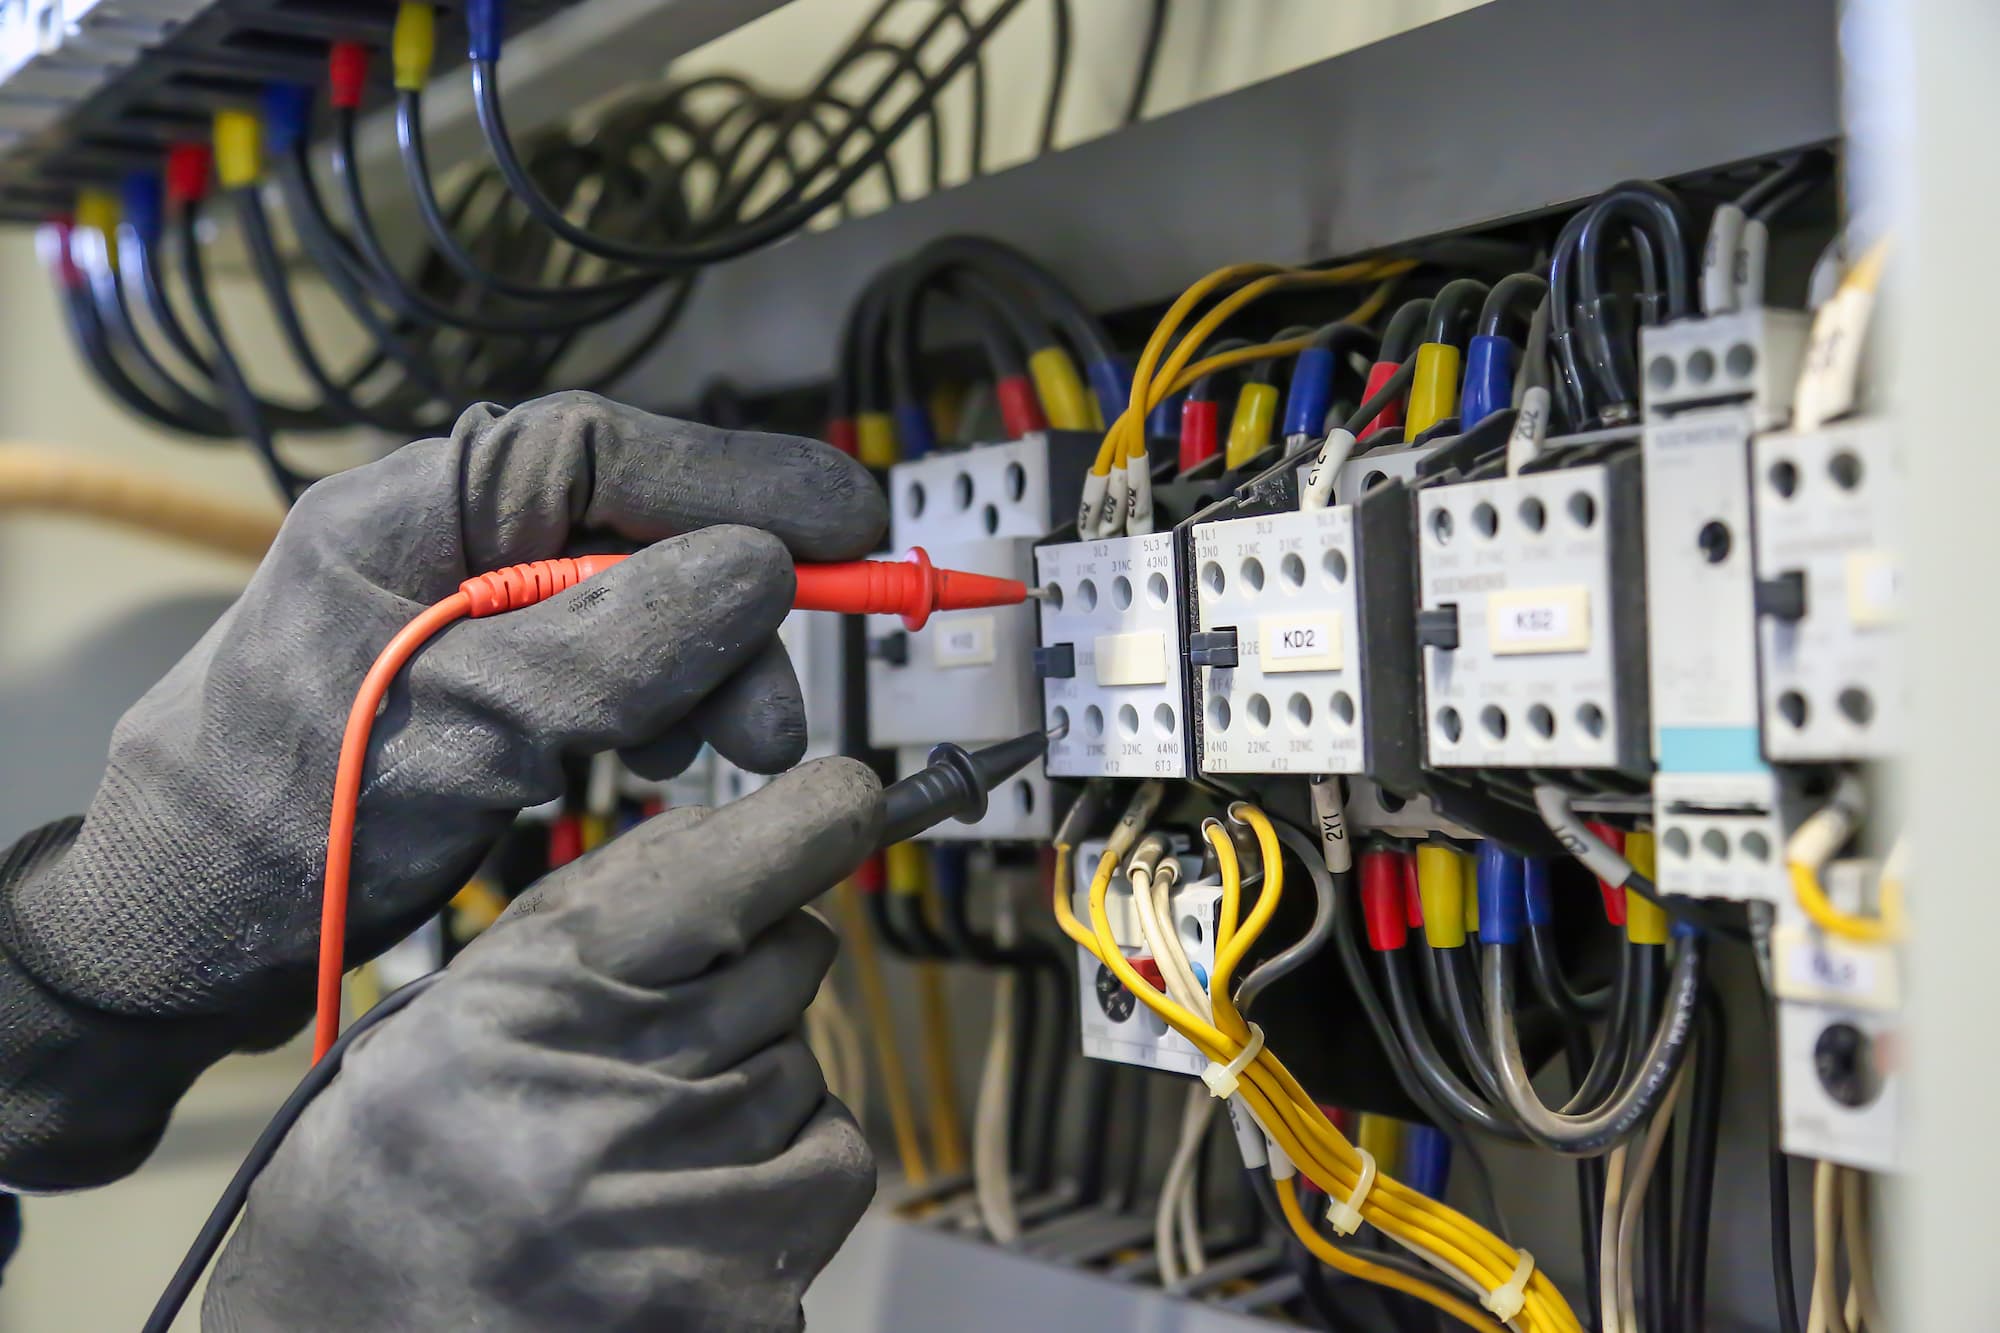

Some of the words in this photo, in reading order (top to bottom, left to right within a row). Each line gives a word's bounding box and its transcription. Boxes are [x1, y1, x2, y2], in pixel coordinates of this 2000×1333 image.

[1201, 529, 1216, 541] 1L1
[1143, 540, 1161, 552] 5L3
[1283, 630, 1315, 649] KD2
[1122, 743, 1143, 756] 32NC
[1155, 760, 1172, 772] 6T3
[1211, 758, 1228, 771] 2T1
[1322, 813, 1343, 842] 2Y1
